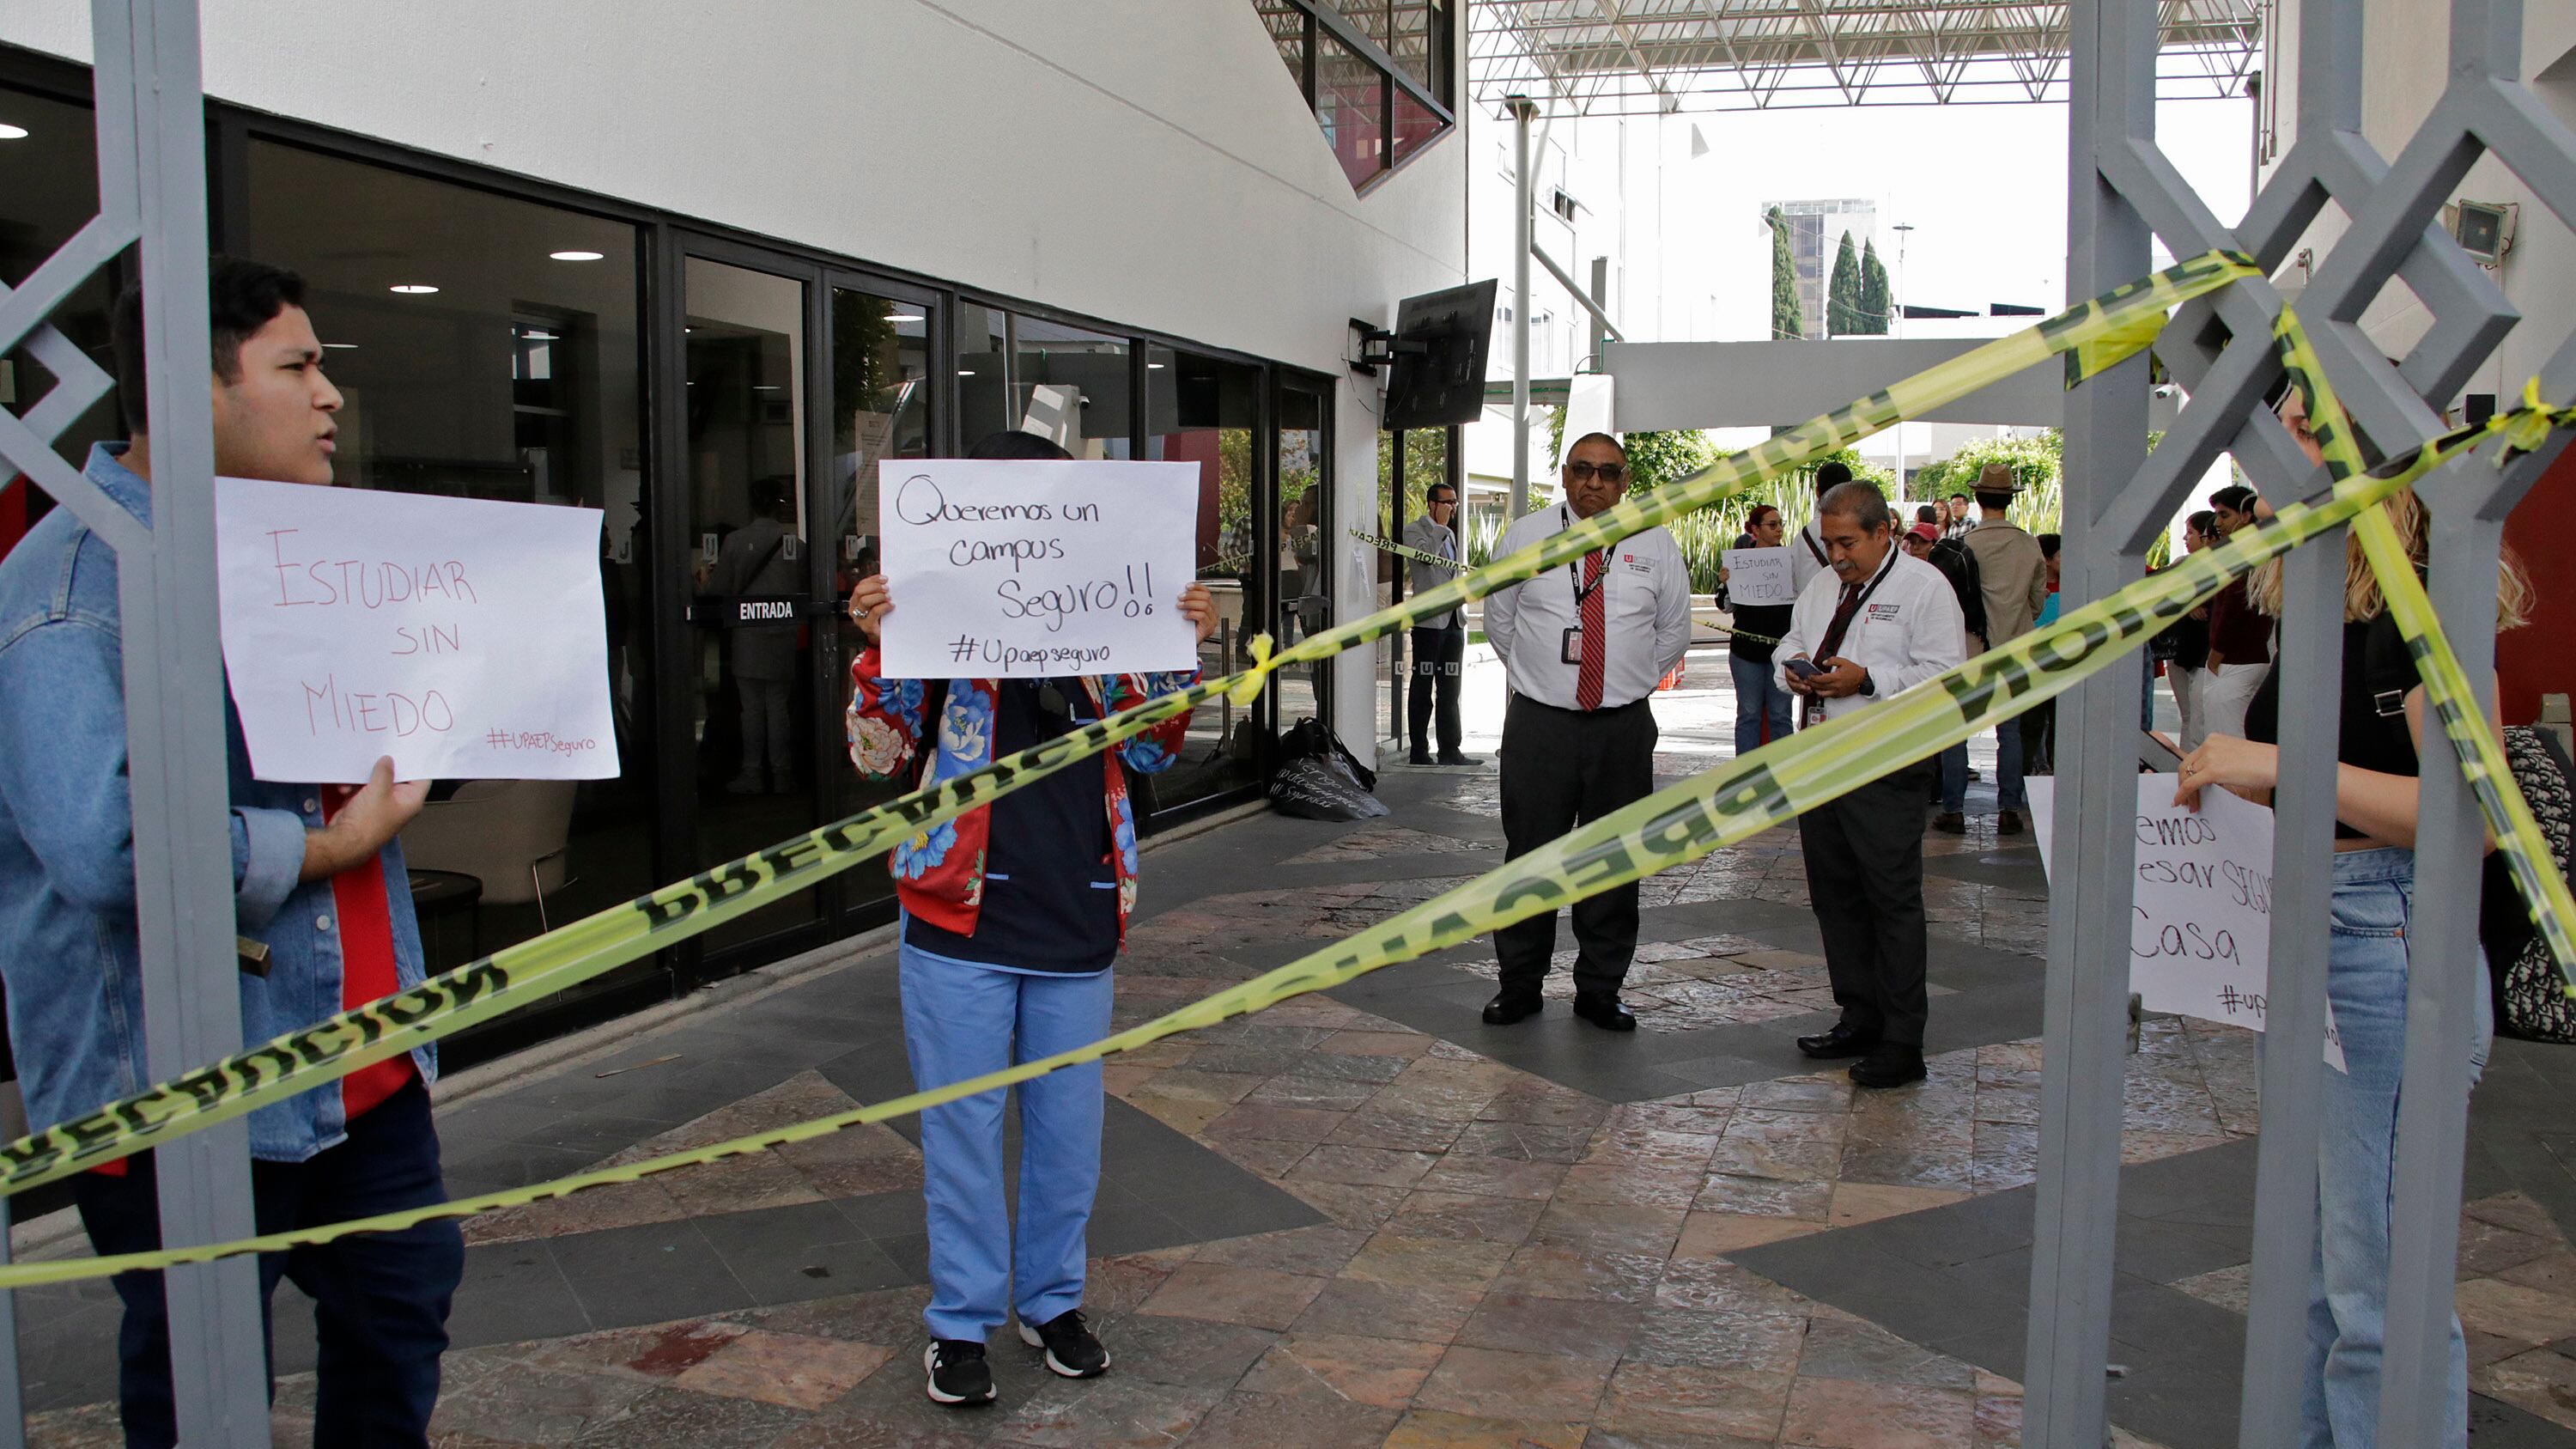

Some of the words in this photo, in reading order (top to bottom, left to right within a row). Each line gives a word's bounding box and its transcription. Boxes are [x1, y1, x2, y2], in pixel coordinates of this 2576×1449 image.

[896, 473, 1053, 526] Queremos
[1062, 500, 1099, 524] un
[265, 529, 477, 609] ESTUDIAR
[949, 536, 1065, 573] campus
[1733, 555, 1783, 569] ESTUDIAR
[1740, 583, 1783, 599] MIEDO
[1762, 572, 1778, 581] SIN
[740, 601, 793, 620] ENTRADA
[392, 624, 459, 654] SIN
[301, 673, 453, 738] MIEDO
[2136, 816, 2216, 845] emos
[2139, 860, 2215, 888] esar
